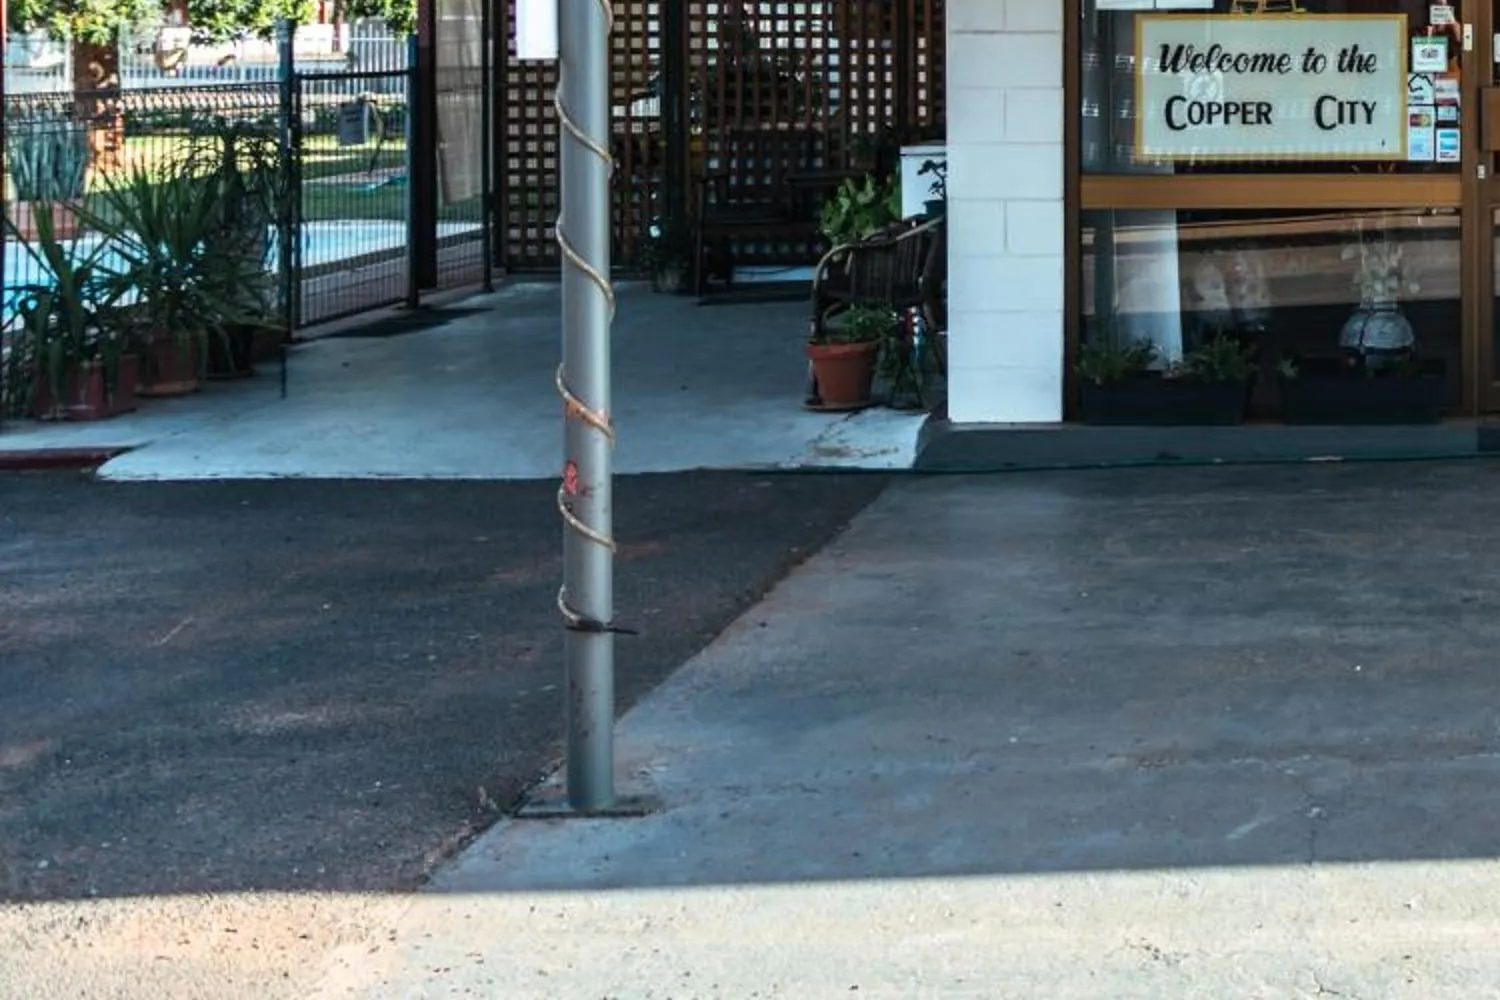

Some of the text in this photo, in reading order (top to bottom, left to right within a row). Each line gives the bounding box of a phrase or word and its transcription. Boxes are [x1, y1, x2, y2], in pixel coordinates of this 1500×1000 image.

[1158, 43, 1378, 74] Welcome to the
[1164, 95, 1377, 131] COPPER CITY
